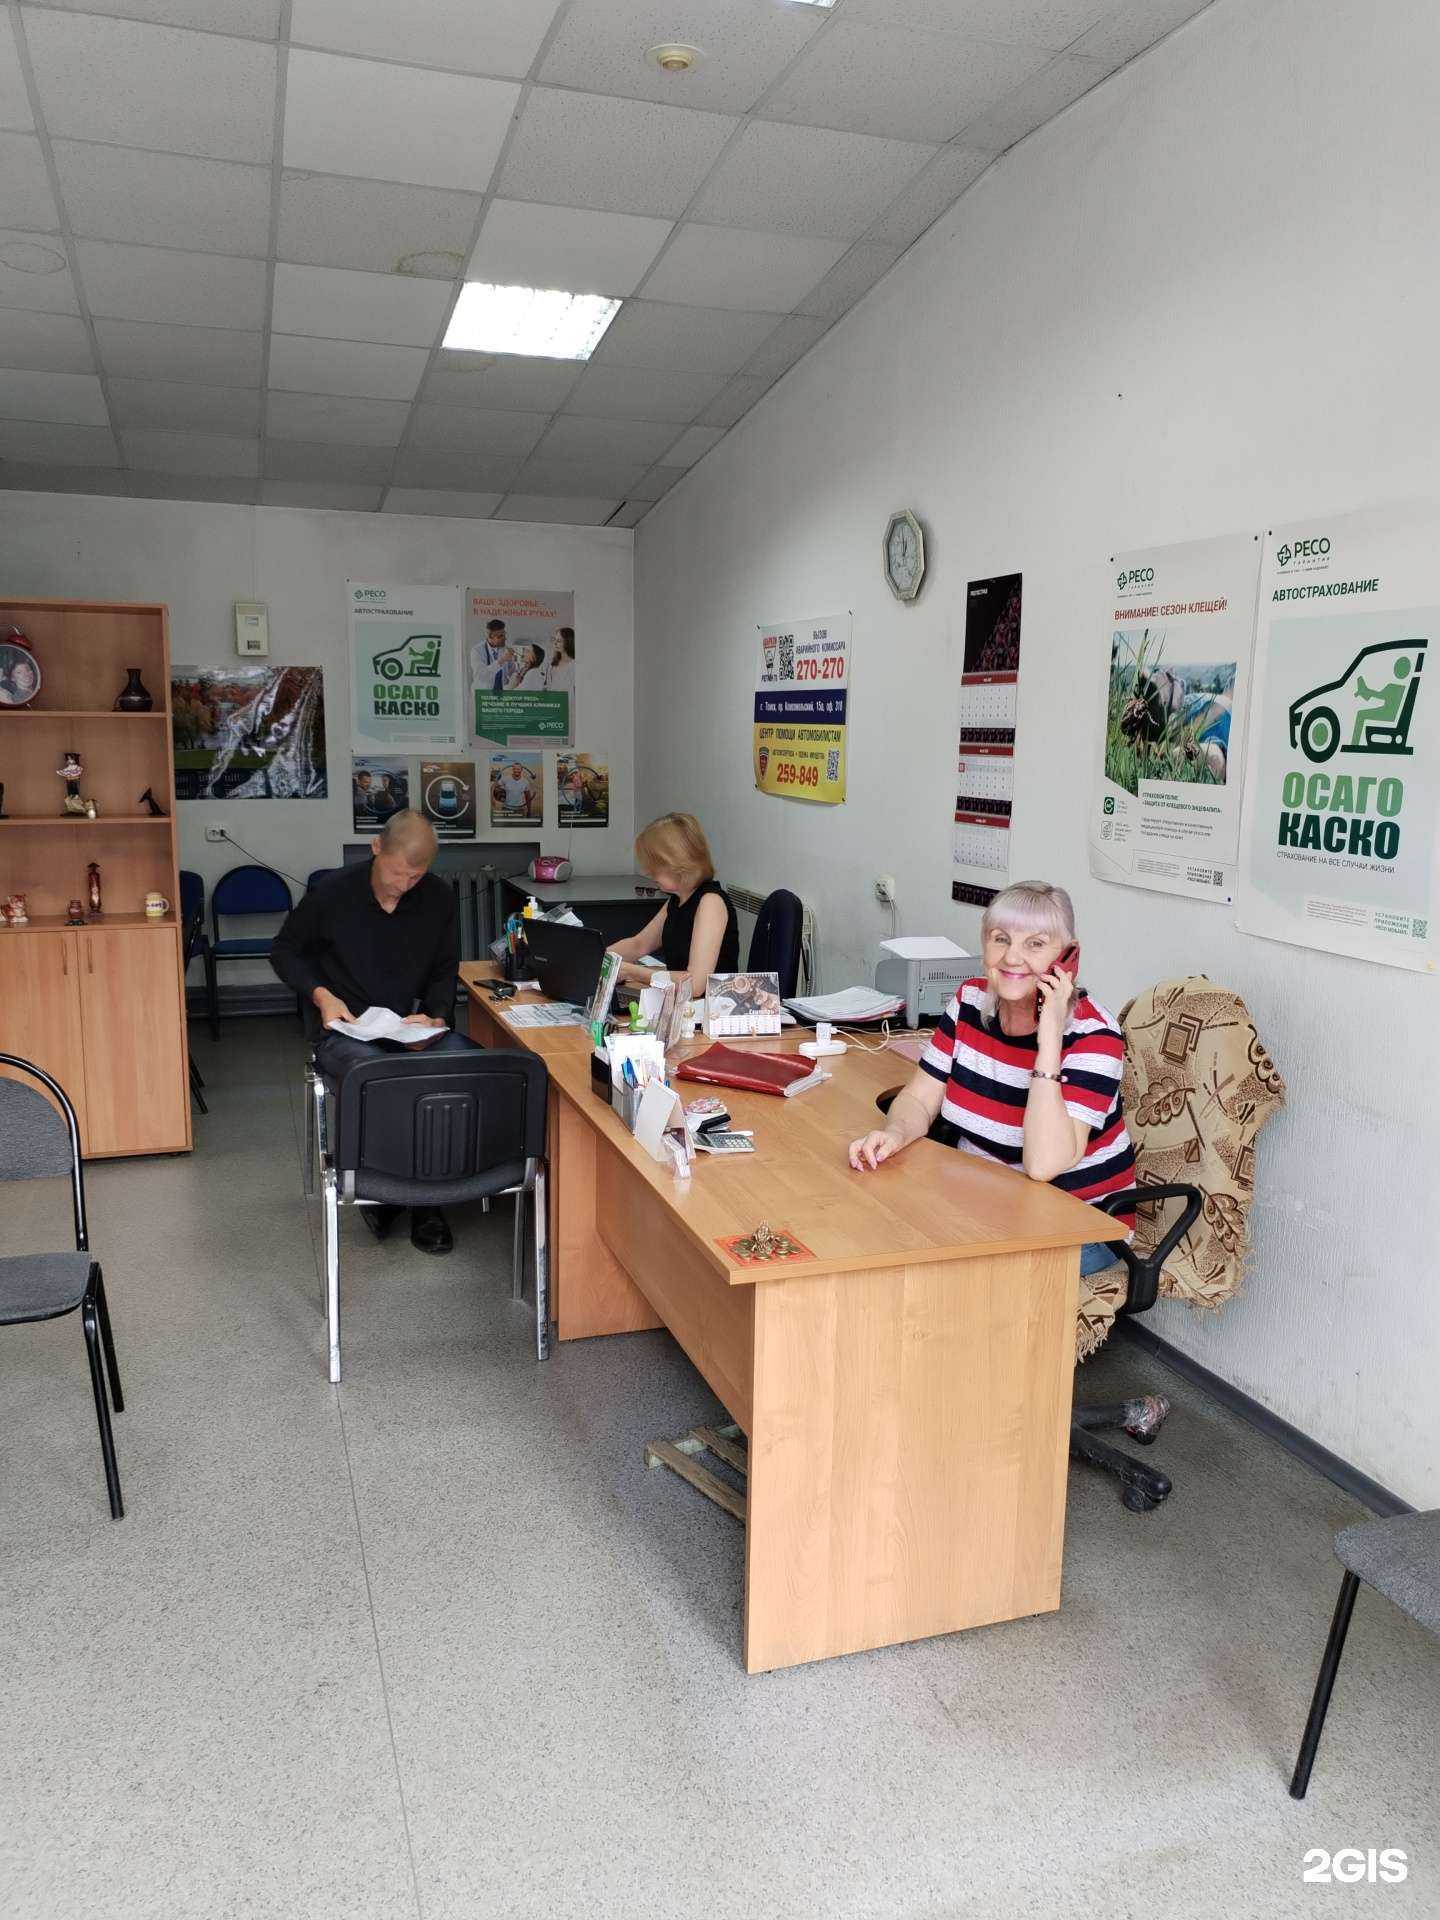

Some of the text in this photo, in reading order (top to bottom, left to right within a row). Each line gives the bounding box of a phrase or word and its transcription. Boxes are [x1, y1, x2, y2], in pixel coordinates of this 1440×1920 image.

[1294, 538, 1331, 558] РЕСО
[1129, 568, 1154, 583] РЕСО
[1272, 579, 1379, 602] АВТОСТРАХОВАНИЕ
[1115, 597, 1228, 620] ВНИМАНИЕ! СЕЗОН КЛЕЩЕЙ!
[796, 656, 845, 681] 270-270
[373, 684, 439, 701] ОСАГО
[374, 700, 440, 716] КАСКО
[776, 762, 819, 787] 259-849
[1282, 771, 1404, 817] ОСАГО
[1278, 812, 1400, 860] КАСКО
[1277, 851, 1318, 863] СТРАХОВАНИЕ
[1318, 856, 1328, 864] НА
[1328, 857, 1340, 867] ВСЕ
[1369, 864, 1395, 874] ЖИЗНИ
